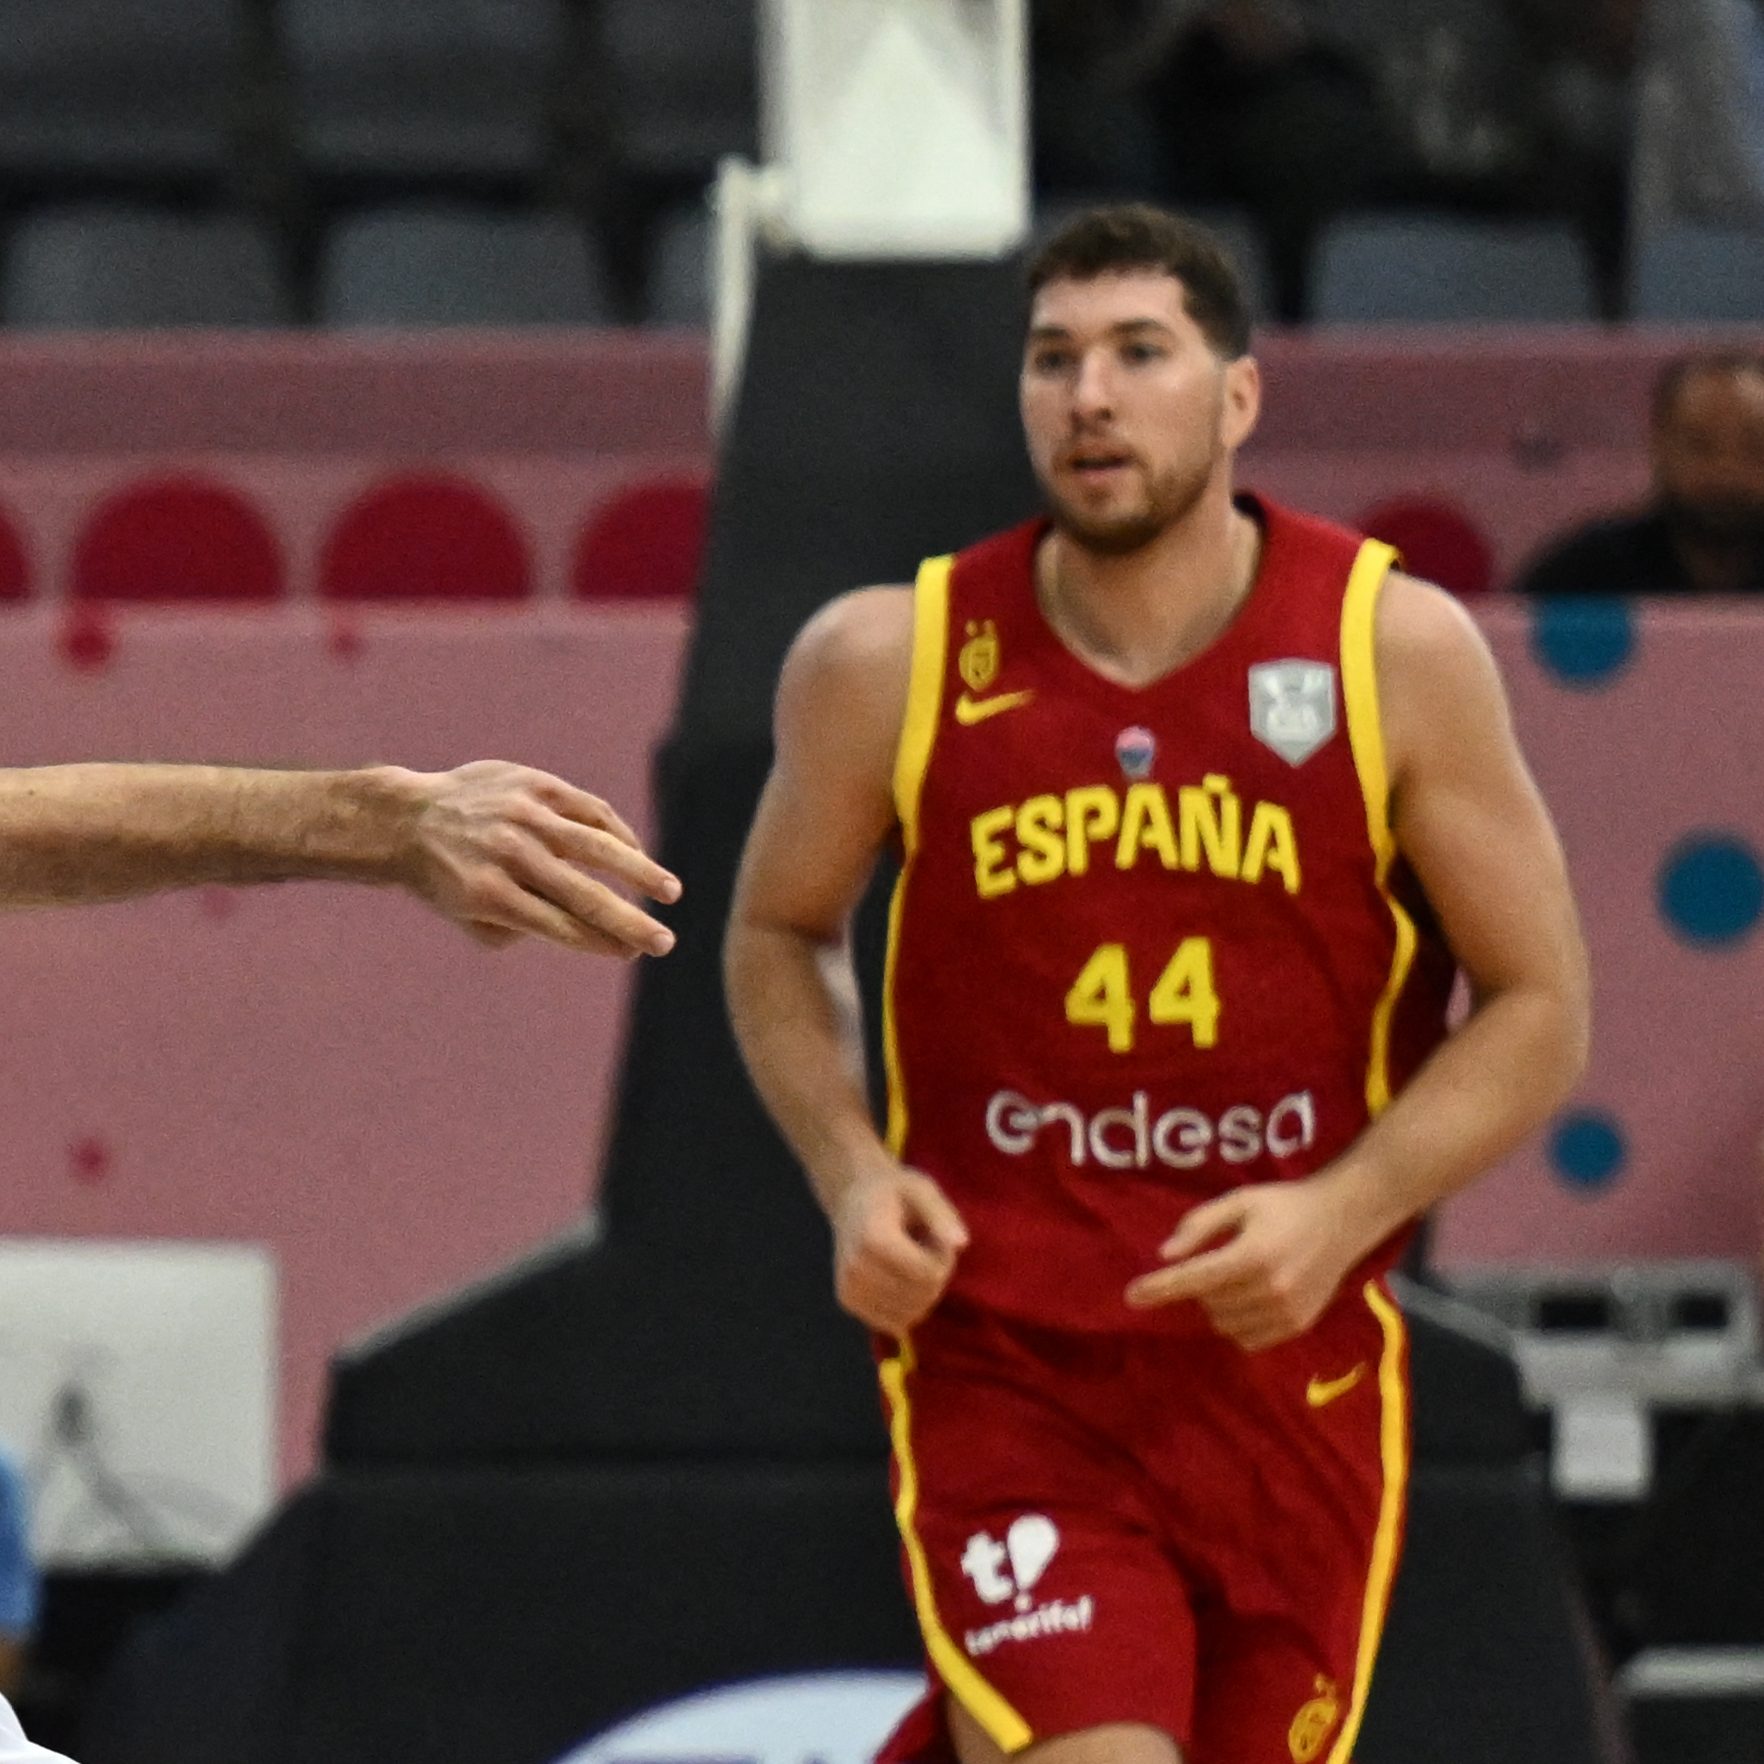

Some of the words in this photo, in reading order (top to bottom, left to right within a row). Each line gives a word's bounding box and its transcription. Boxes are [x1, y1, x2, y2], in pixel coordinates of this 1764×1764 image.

[971, 772, 1301, 899] ESPAÑA
[1065, 935, 1222, 1054] 44
[985, 1090, 1318, 1170] endesa
